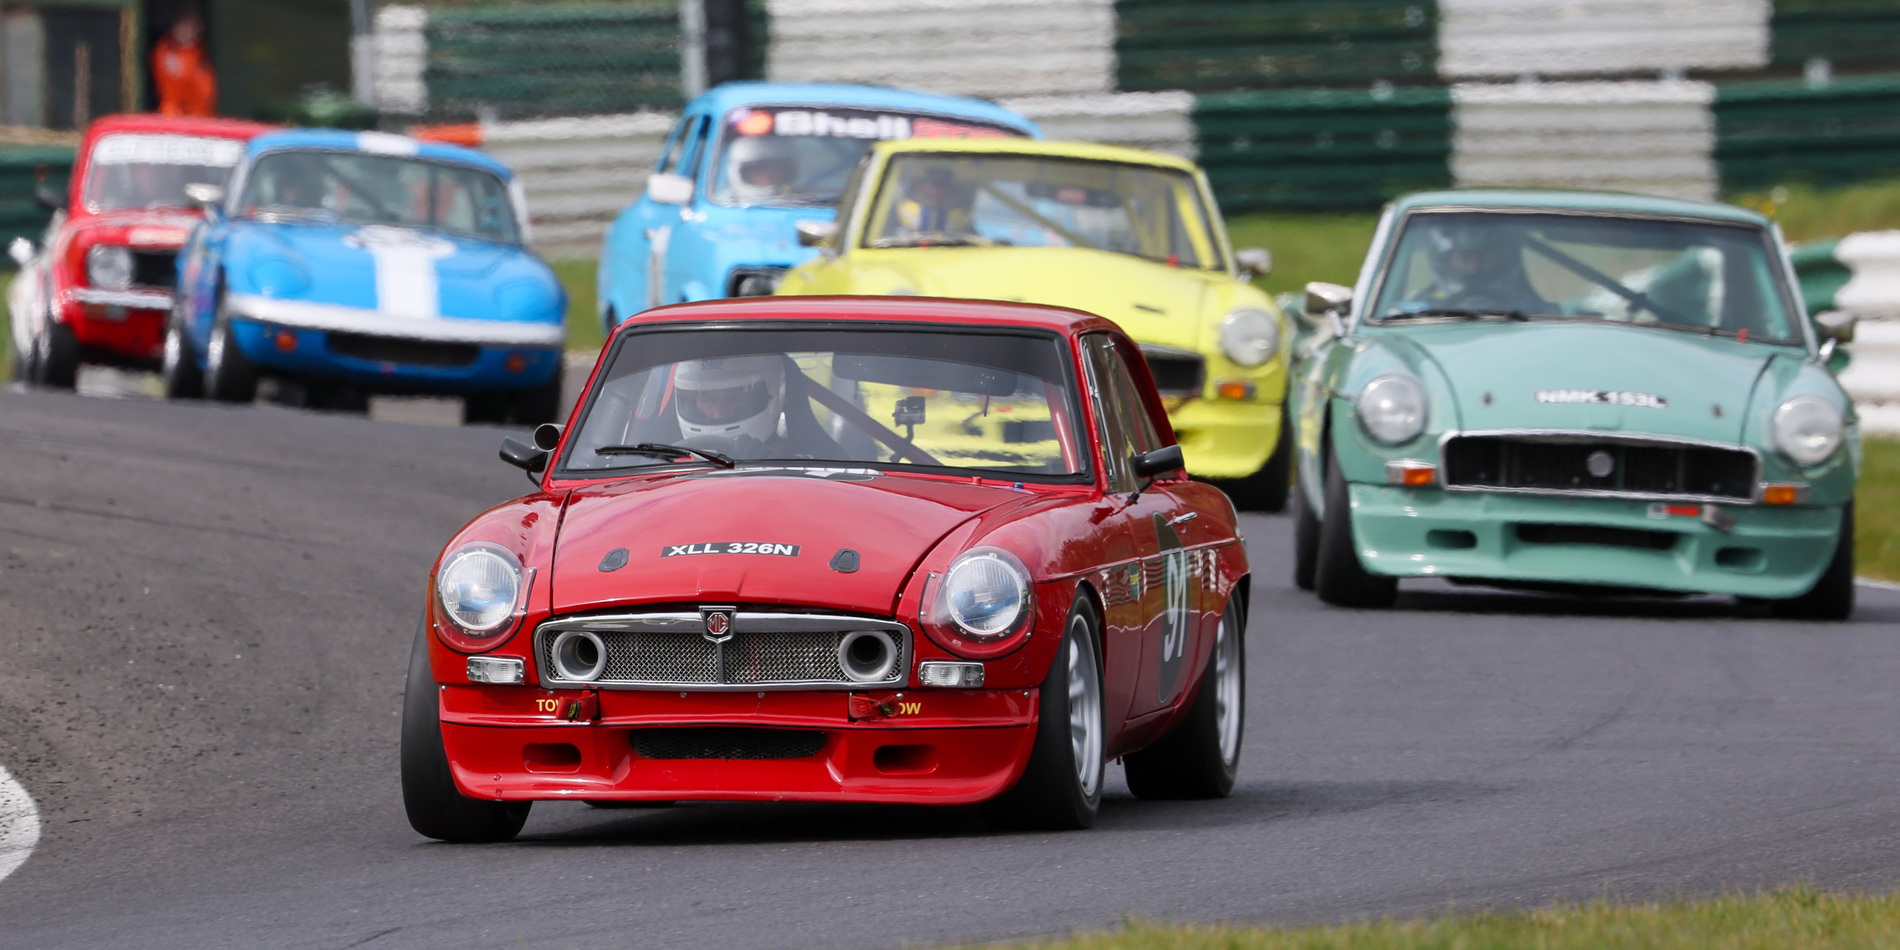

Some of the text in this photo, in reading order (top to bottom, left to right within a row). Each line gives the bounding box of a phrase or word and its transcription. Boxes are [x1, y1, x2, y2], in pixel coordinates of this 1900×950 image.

[774, 109, 912, 139] Shell
[1536, 389, 1667, 409] NMK 153L
[668, 542, 793, 556] XLL 326N
[1164, 549, 1187, 662] 91
[708, 613, 728, 633] MG
[535, 699, 559, 712] TO
